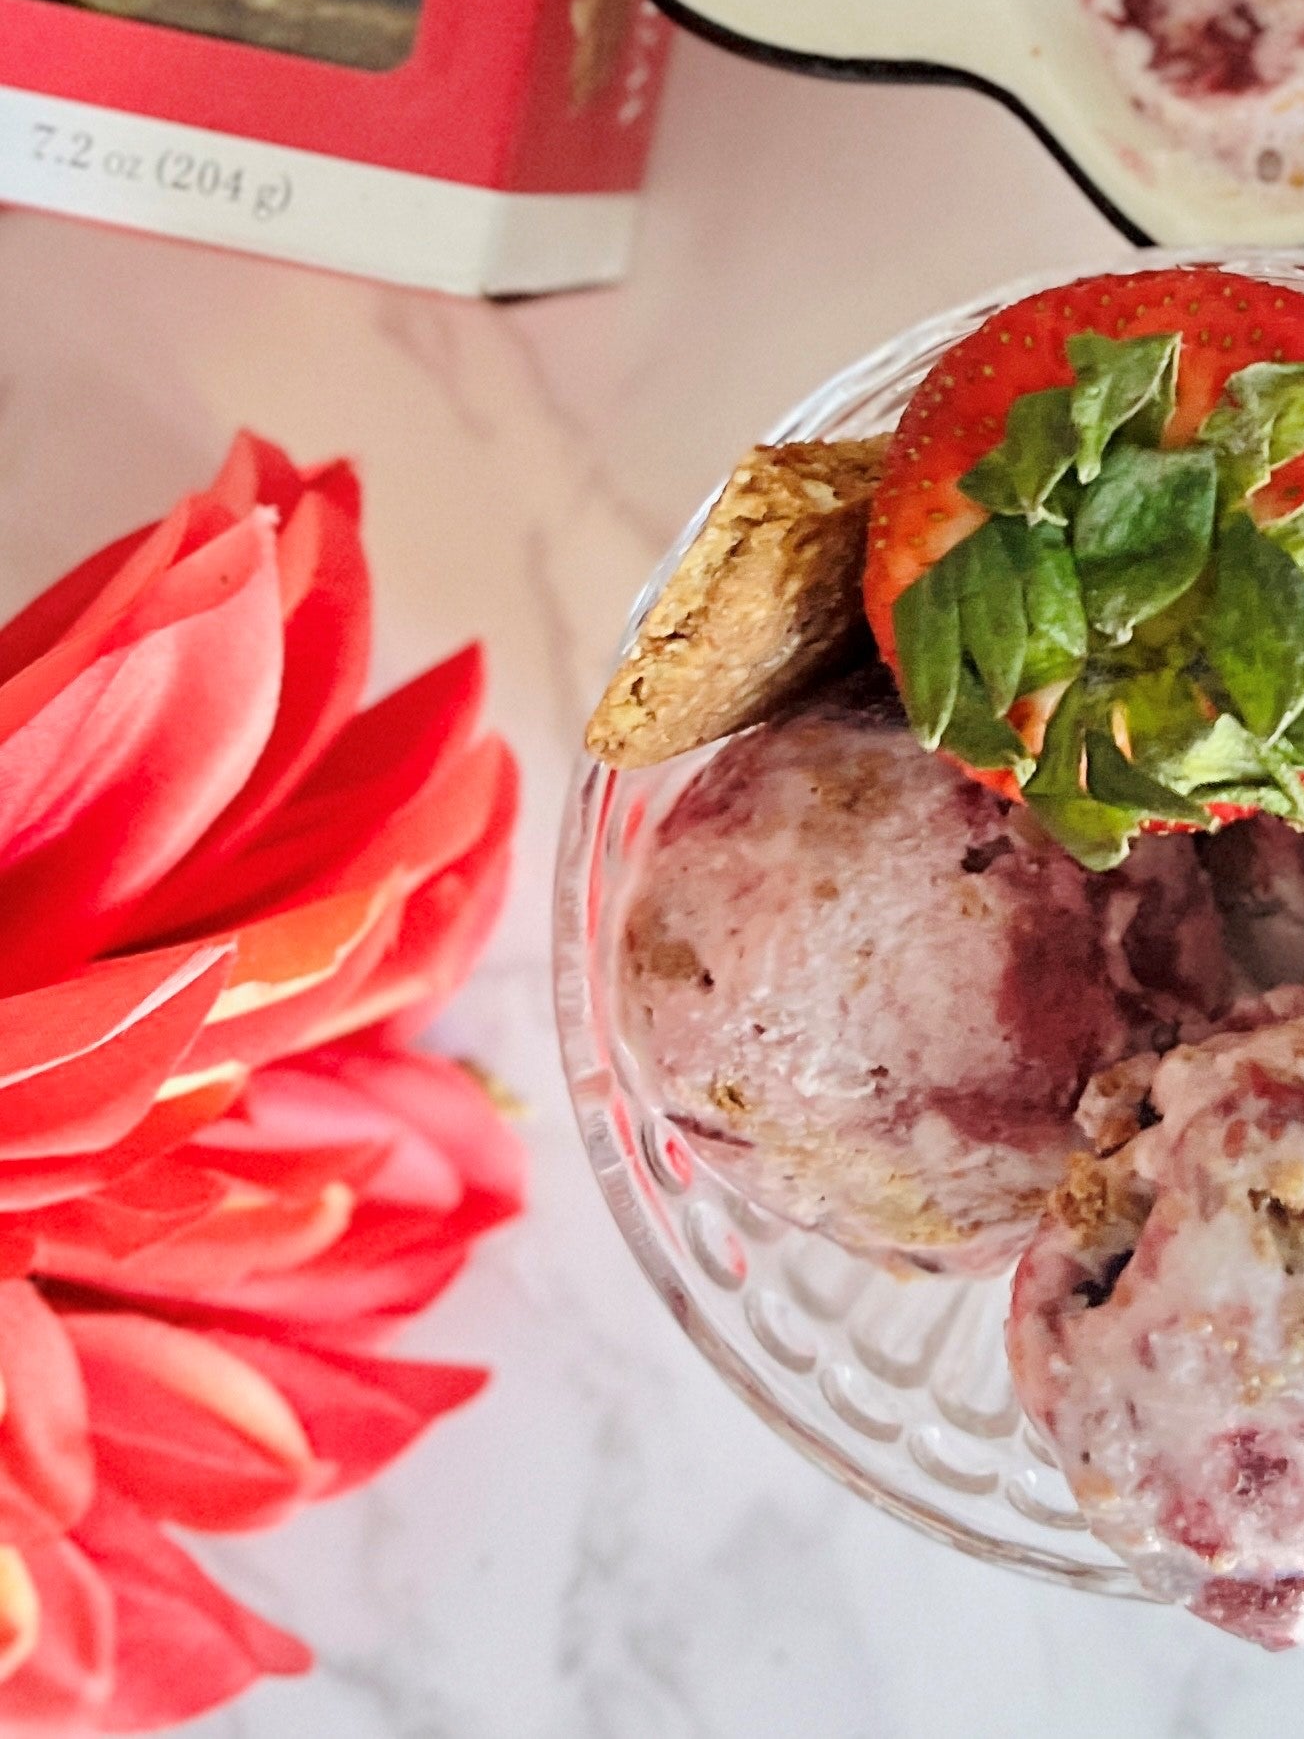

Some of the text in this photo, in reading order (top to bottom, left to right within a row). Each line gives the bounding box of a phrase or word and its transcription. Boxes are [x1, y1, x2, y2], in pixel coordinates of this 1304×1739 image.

[31, 121, 294, 223] 7.2 oz (204 g)
